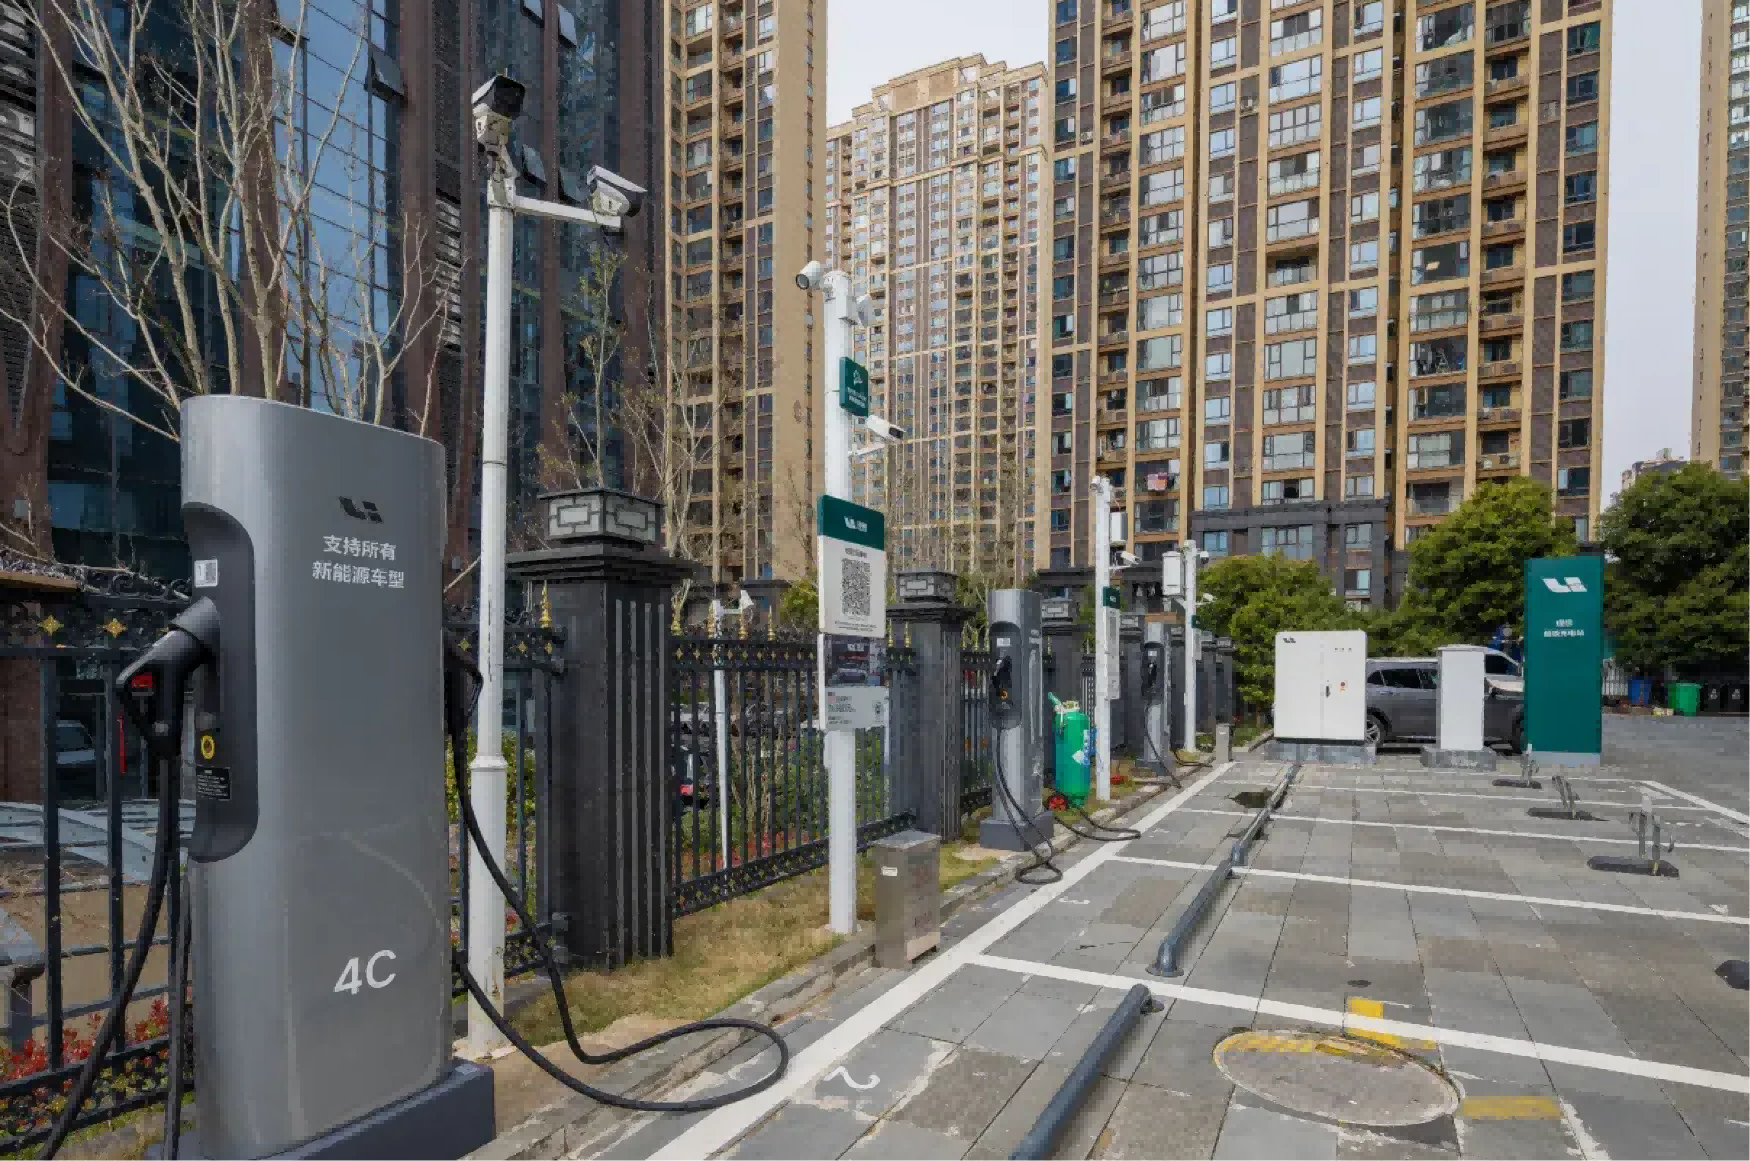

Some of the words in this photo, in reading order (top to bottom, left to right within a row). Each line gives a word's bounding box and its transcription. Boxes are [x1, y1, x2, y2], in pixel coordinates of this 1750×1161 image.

[323, 535, 396, 561] 支持所有
[312, 561, 405, 589] 新能源车型
[333, 949, 397, 995] 4C
